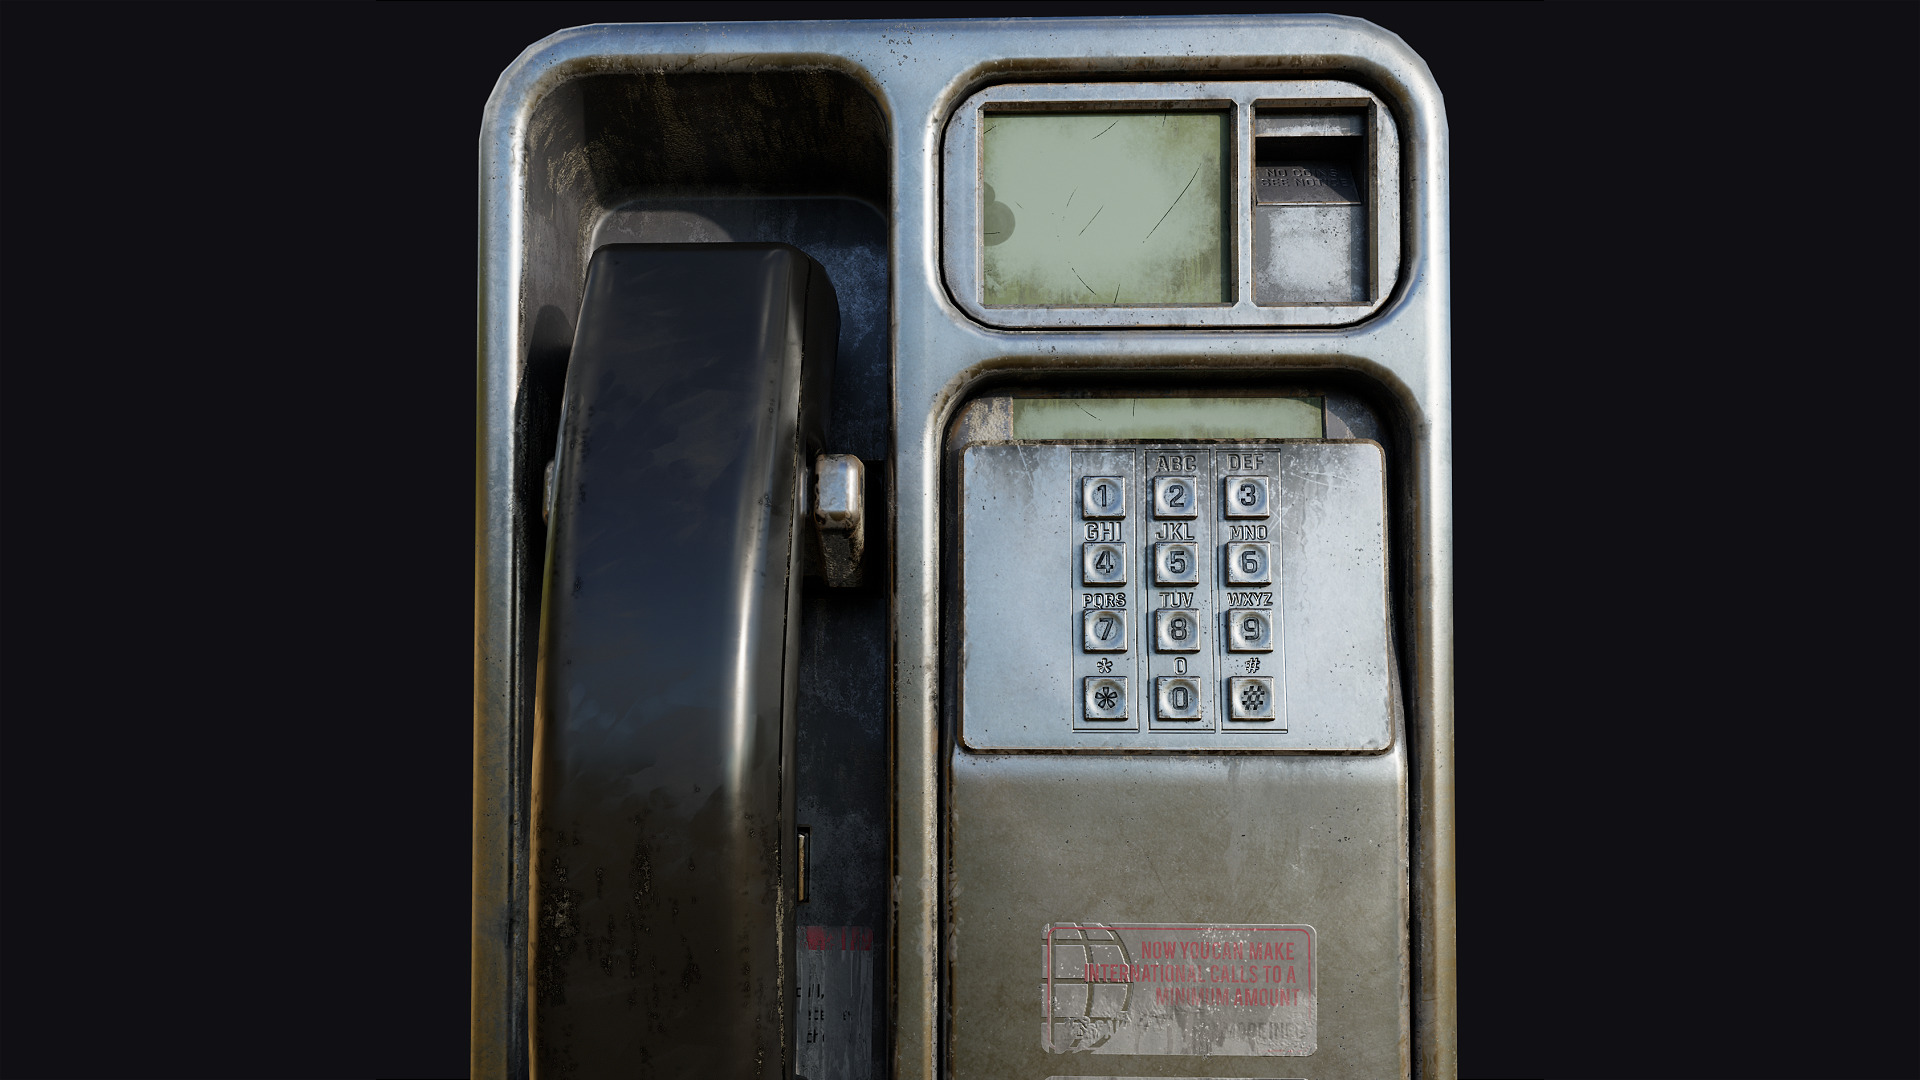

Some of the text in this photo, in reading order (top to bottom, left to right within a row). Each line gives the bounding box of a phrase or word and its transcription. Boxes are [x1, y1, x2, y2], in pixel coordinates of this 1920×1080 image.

[1266, 168, 1339, 177] NO COINS
[1261, 178, 1290, 187] SEE
[1156, 455, 1197, 472] ABC
[1227, 453, 1264, 471] DEF
[1097, 484, 1108, 508] 1
[1169, 484, 1185, 508] 2
[1240, 484, 1256, 506] 3
[1084, 521, 1122, 541] GHI
[1155, 522, 1195, 541] JKL
[1228, 525, 1268, 541] MNO
[1095, 550, 1114, 574] 4
[1169, 550, 1186, 574] 5
[1241, 550, 1258, 574] 6
[1082, 593, 1126, 609] PQRS
[1159, 592, 1194, 608] TUV
[1227, 592, 1273, 607] WXYZ
[1098, 617, 1114, 641] 7
[1171, 617, 1188, 641] 8
[1243, 617, 1260, 640] 9
[1172, 686, 1188, 710] 0
[1142, 941, 1177, 959] NOW
[1249, 942, 1295, 960] MAKE
[1084, 964, 1296, 983] INTERNATIONAL CALLS TO A
[1156, 987, 1300, 1006] MINIMUM AMOUNT
